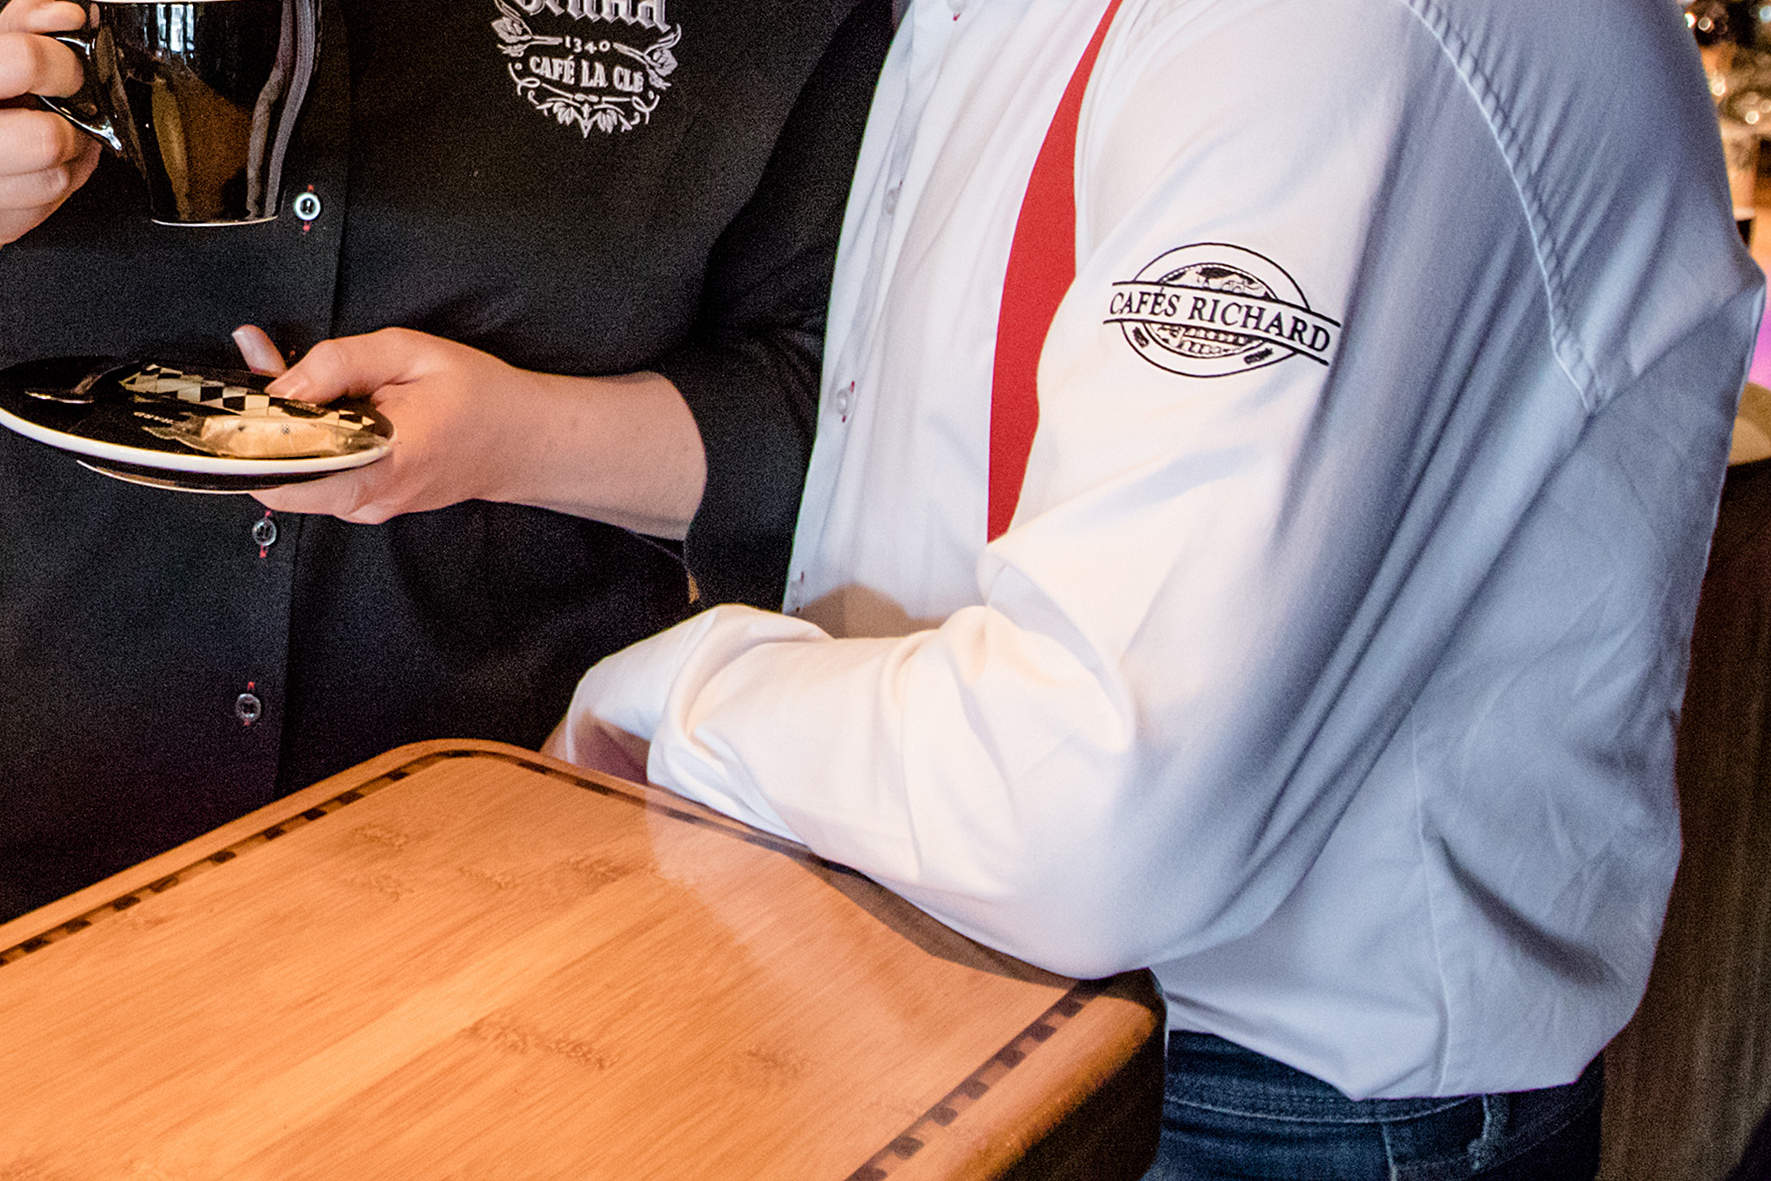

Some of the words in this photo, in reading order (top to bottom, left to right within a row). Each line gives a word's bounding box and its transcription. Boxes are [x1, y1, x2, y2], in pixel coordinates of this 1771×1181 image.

[564, 35, 612, 54] 1340
[529, 55, 576, 86] CAFÉ
[580, 58, 609, 88] LA
[1109, 287, 1182, 317] CAFÉS
[1188, 296, 1331, 353] RICHARD
